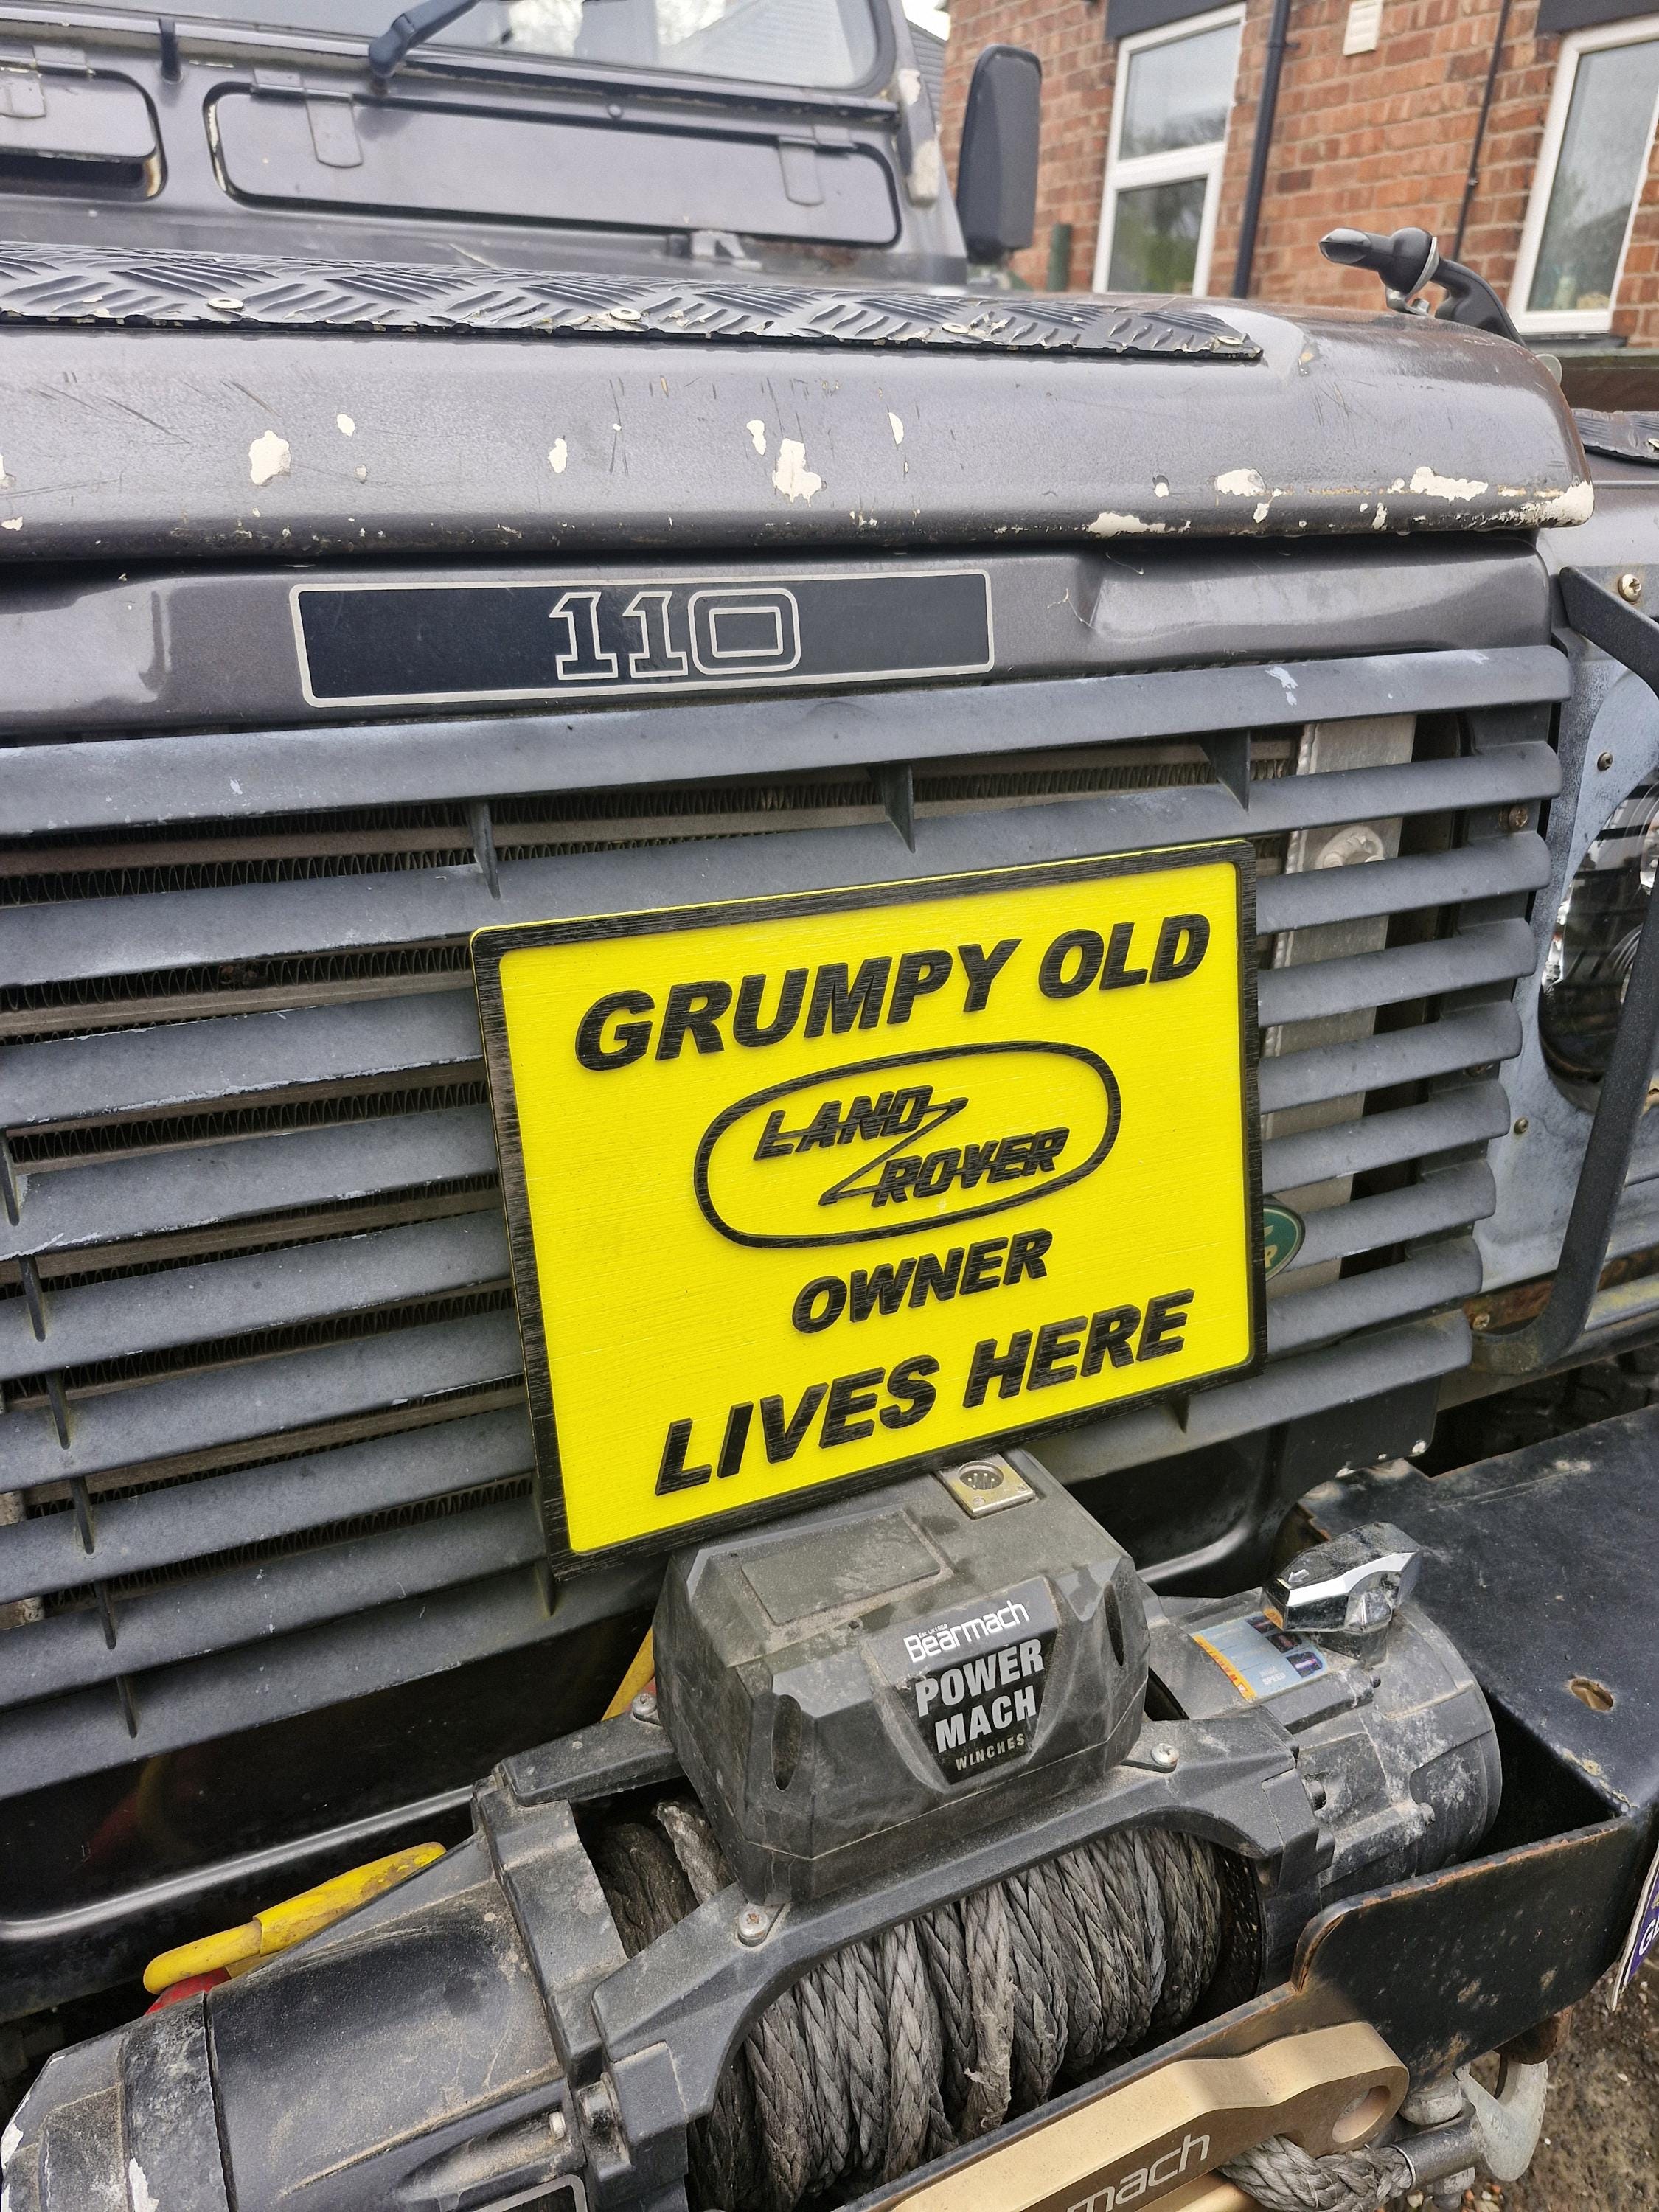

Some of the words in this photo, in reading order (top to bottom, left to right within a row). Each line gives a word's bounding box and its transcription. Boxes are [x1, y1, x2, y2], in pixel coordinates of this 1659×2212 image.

[549, 588, 801, 681] 110
[574, 938, 1022, 1072] GRUMPY
[1037, 913, 1211, 1000] OLD
[753, 1085, 935, 1161] LAND
[872, 1126, 1071, 1208] ROVER
[791, 1228, 1053, 1334] OWNER
[654, 1354, 940, 1496] LIVES
[962, 1288, 1195, 1409] HERE
[903, 1600, 1030, 1663] Bearmach
[915, 1638, 1044, 1717] POWER
[934, 1685, 1037, 1754] MACH
[955, 1733, 1025, 1771] WINCHES
